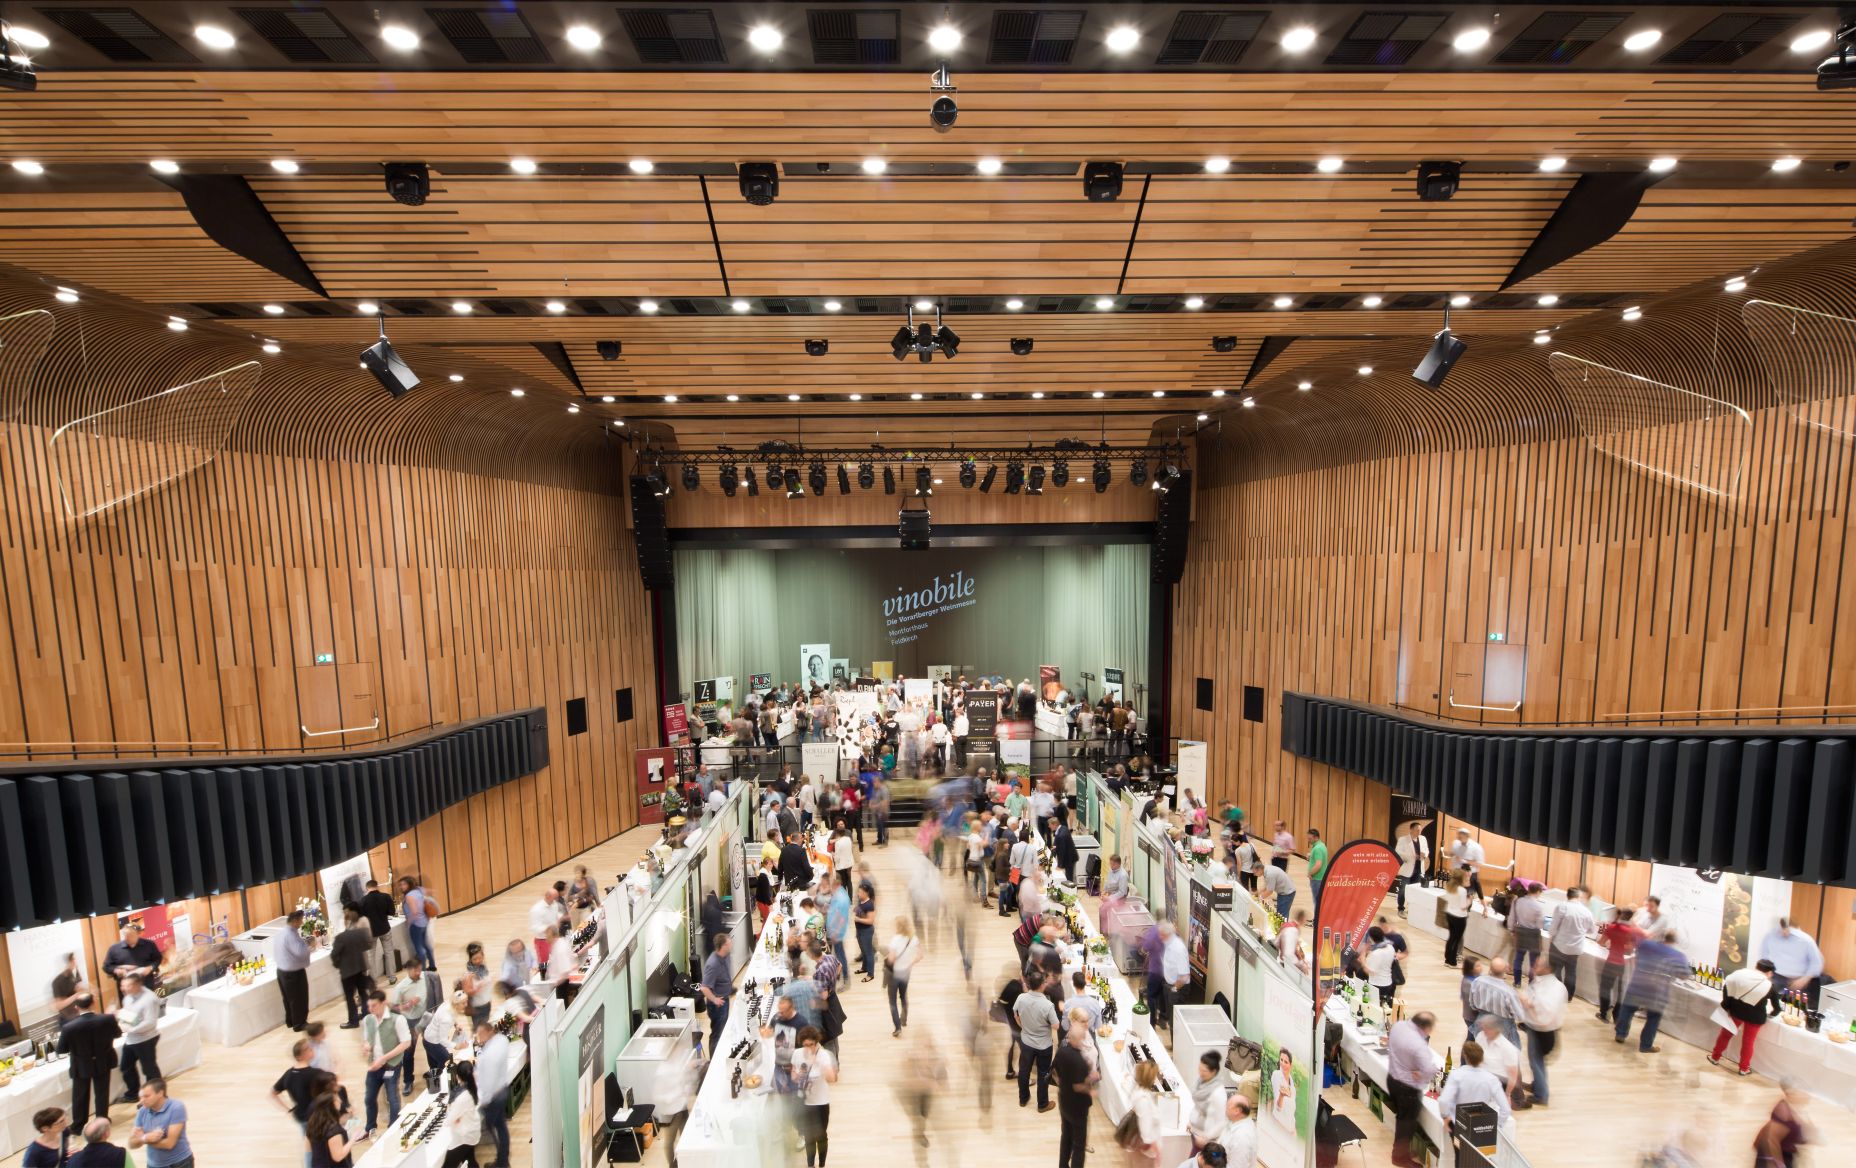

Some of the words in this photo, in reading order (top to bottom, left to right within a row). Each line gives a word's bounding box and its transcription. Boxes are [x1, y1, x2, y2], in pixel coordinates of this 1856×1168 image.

[882, 570, 975, 617] vinobile
[898, 608, 939, 623] Vorarlberger
[939, 599, 977, 613] Weinmesse
[888, 622, 929, 636] Montforthaus
[891, 635, 918, 646] Feldkirch
[1327, 878, 1375, 887] waldschütz
